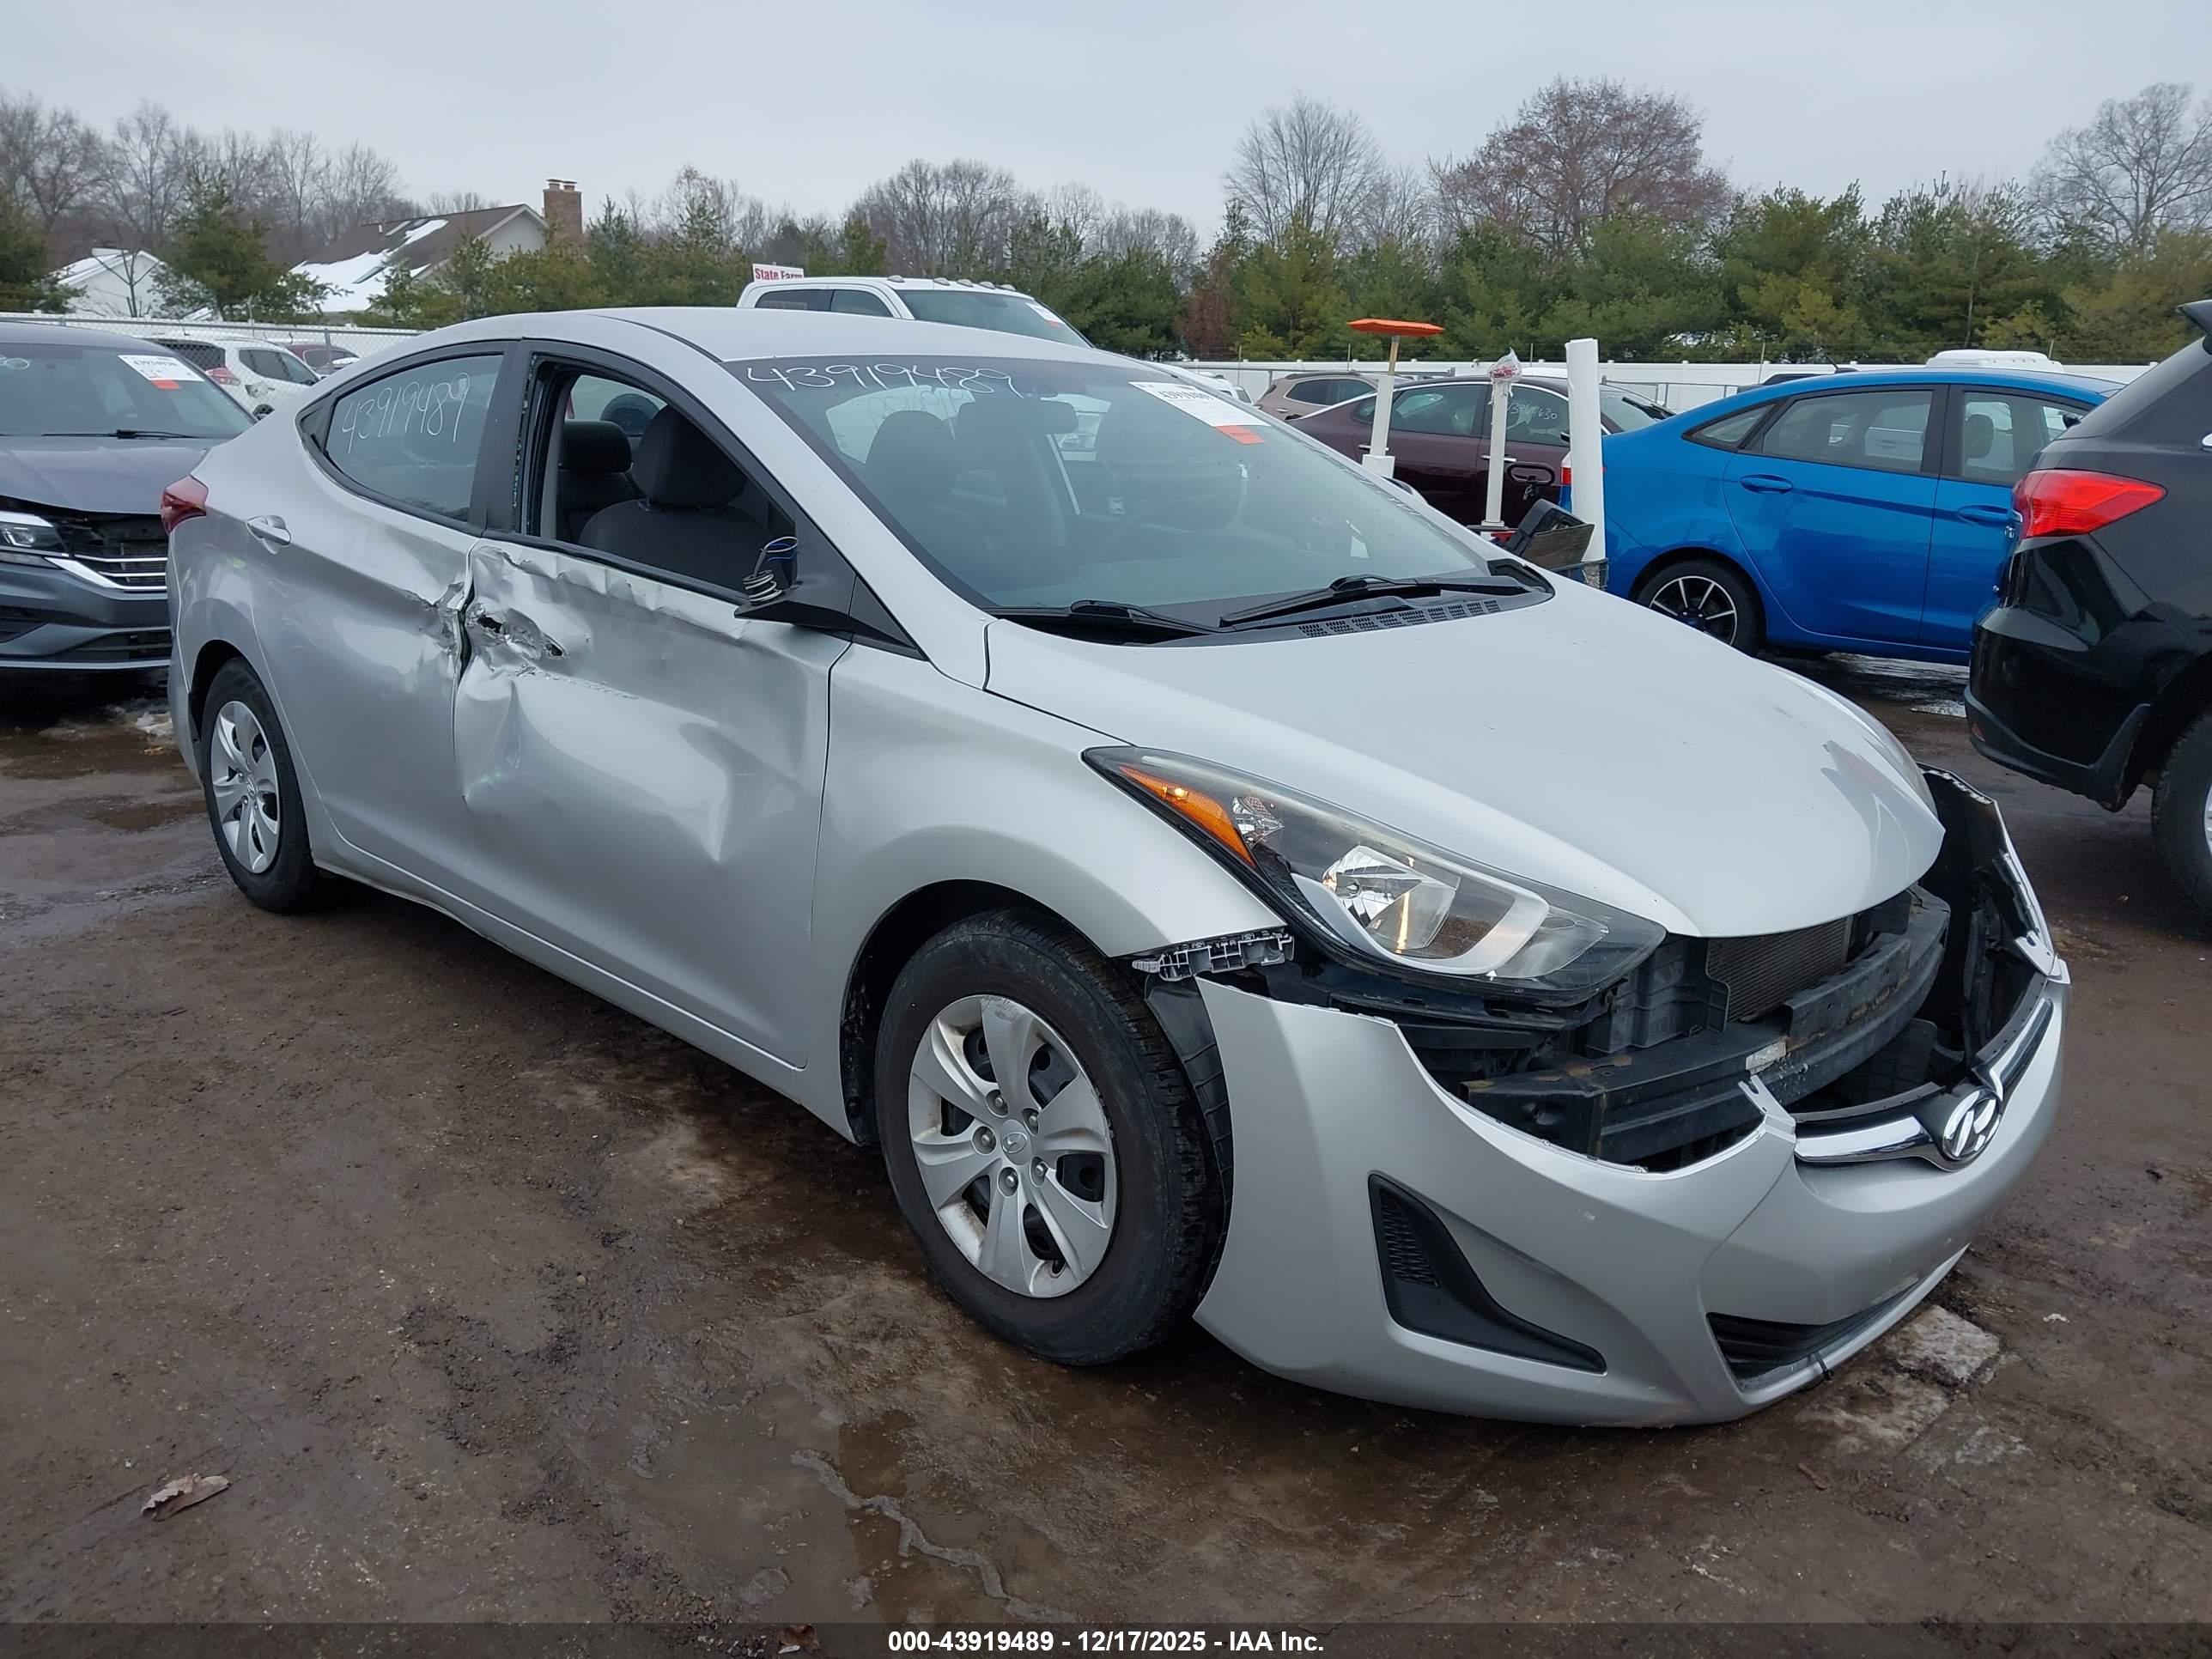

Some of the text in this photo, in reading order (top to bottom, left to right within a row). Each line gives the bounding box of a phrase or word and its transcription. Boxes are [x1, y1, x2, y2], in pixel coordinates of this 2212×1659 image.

[754, 268, 803, 281] State Farm
[747, 362, 1024, 399] 43919489
[342, 372, 471, 454] 43919489
